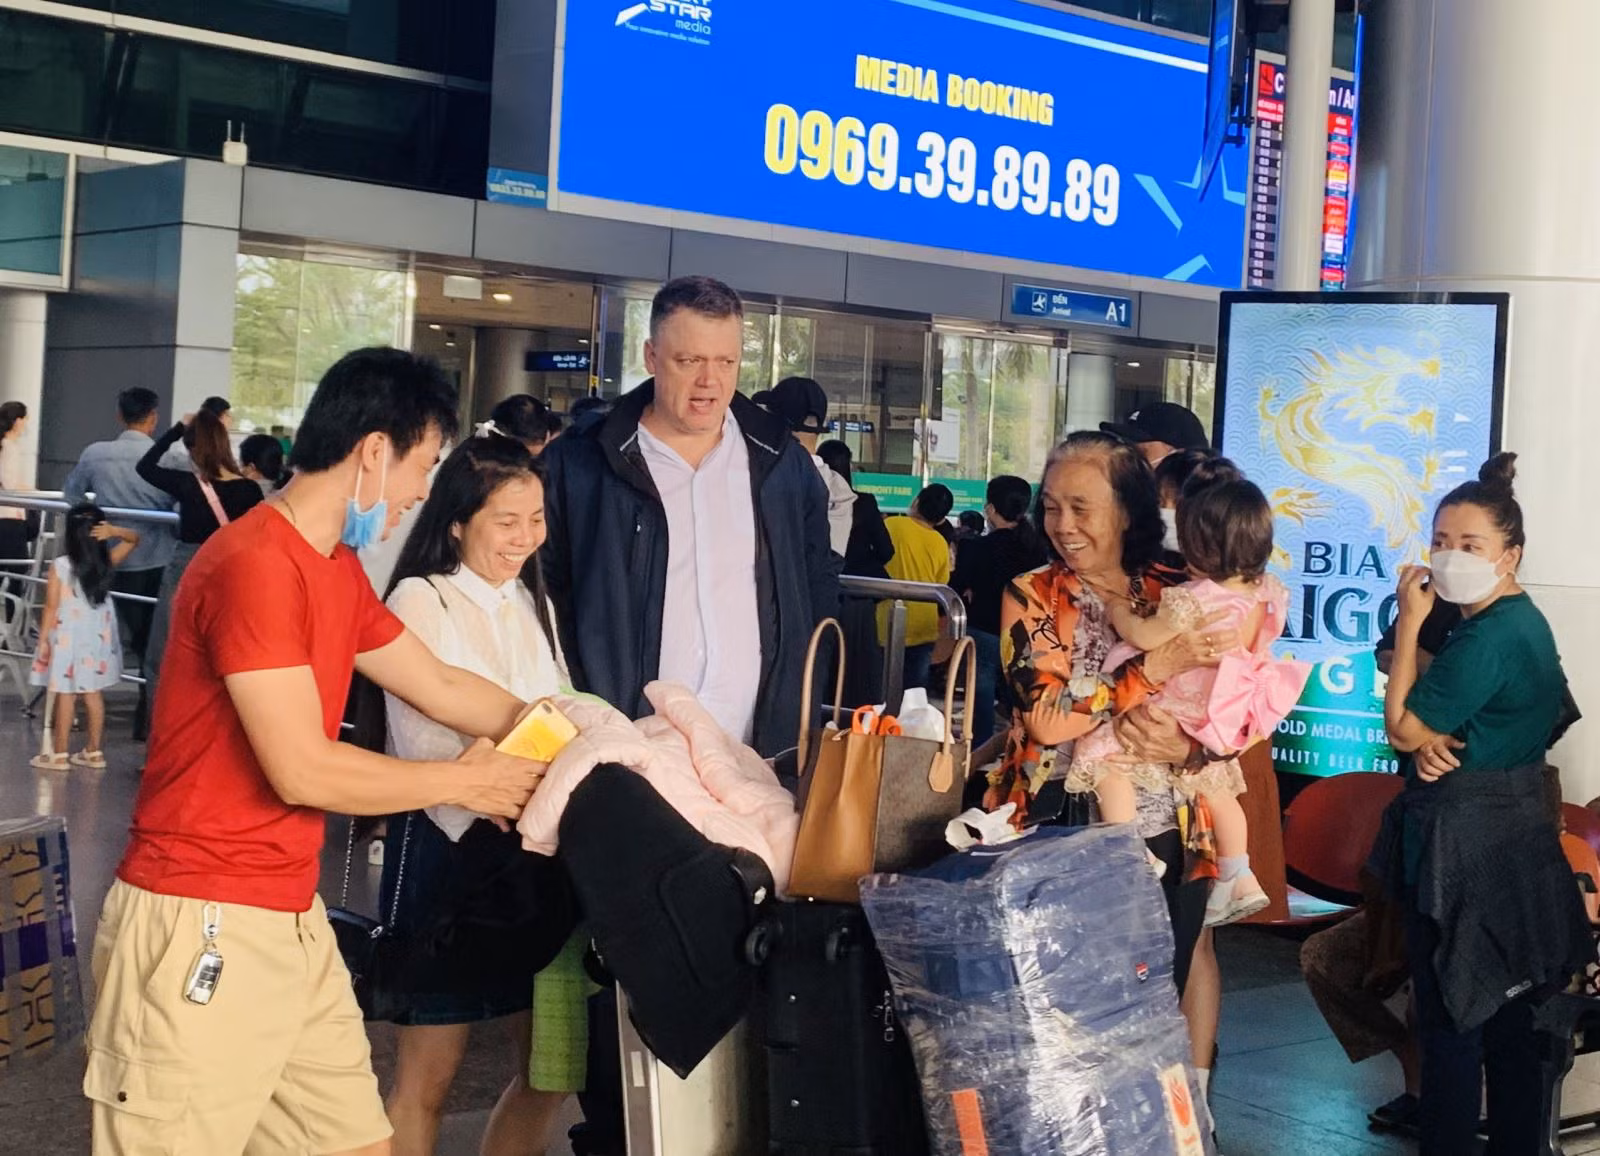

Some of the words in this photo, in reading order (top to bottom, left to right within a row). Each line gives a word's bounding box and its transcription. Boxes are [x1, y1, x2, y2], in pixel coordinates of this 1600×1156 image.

[649, 0, 712, 22] STAR
[675, 19, 711, 35] media
[855, 54, 940, 104] MEDIA
[946, 73, 1054, 126] BOOKING
[764, 103, 1120, 226] 0969.39.89.89
[1105, 301, 1126, 322] A1
[1303, 541, 1389, 582] BIA
[1272, 718, 1307, 736] OLD
[1311, 723, 1363, 743] MEDAL
[1272, 746, 1321, 766] UALITY
[1328, 751, 1365, 770] BEER
[1372, 757, 1399, 774] FRO
